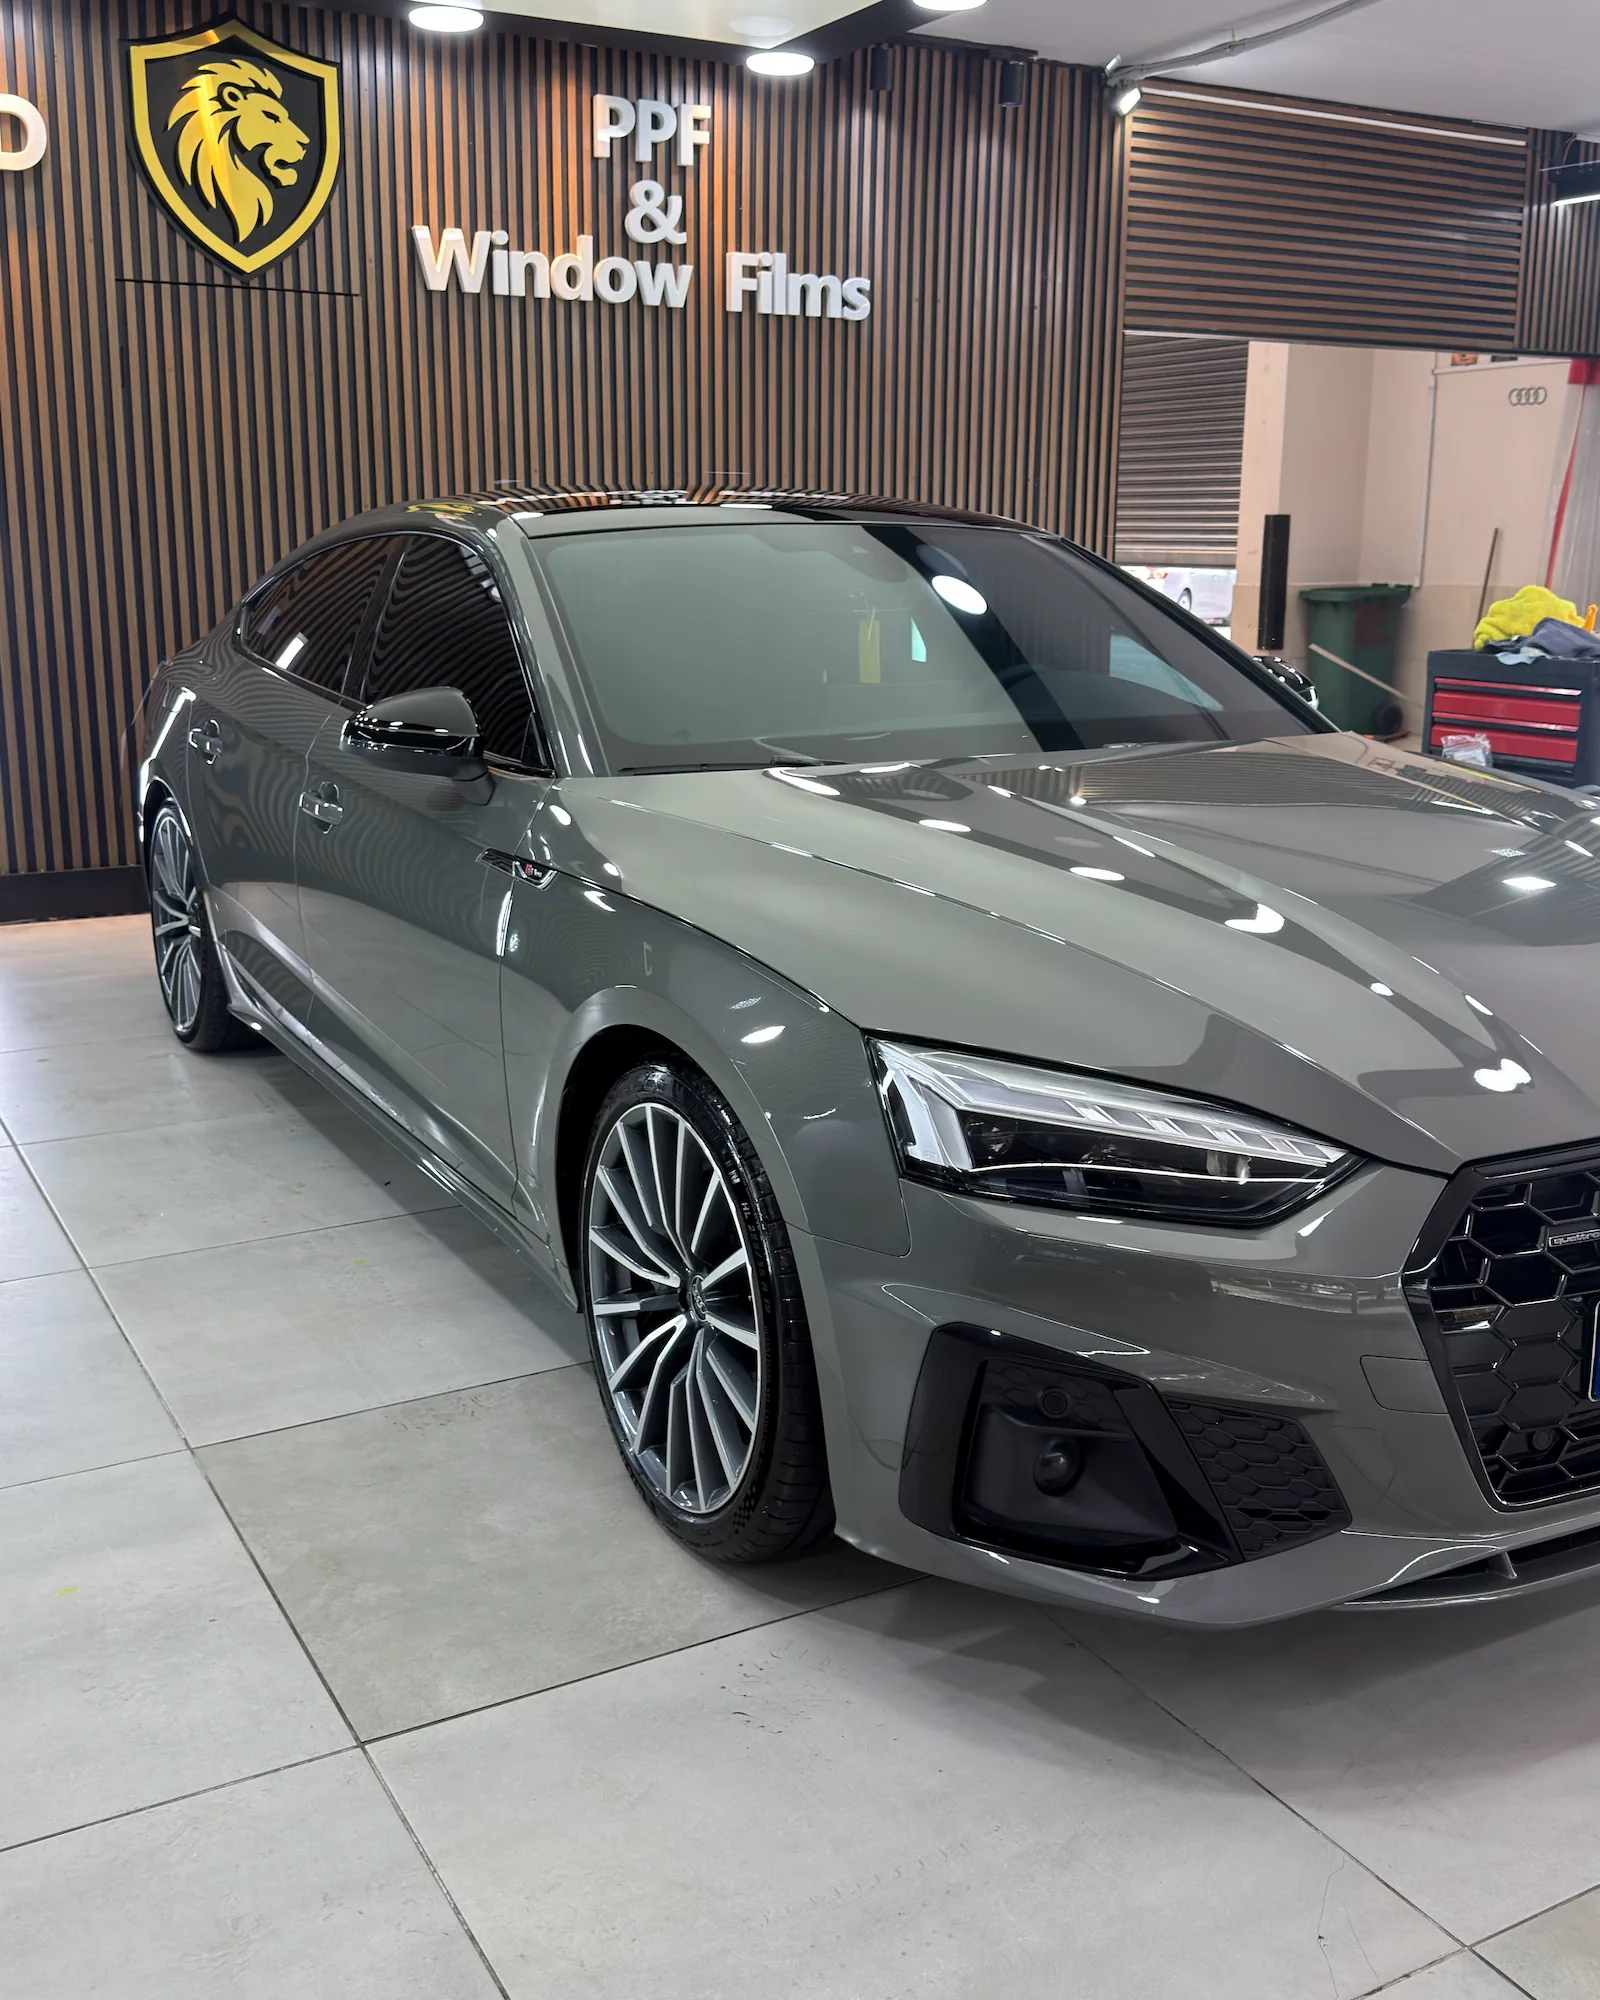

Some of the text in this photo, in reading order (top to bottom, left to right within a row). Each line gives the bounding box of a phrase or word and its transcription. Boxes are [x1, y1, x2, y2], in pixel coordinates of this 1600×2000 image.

[593, 94, 711, 166] PPF
[624, 179, 687, 245] &
[412, 225, 871, 321] Window Films
[1554, 1232, 1600, 1245] quattro
